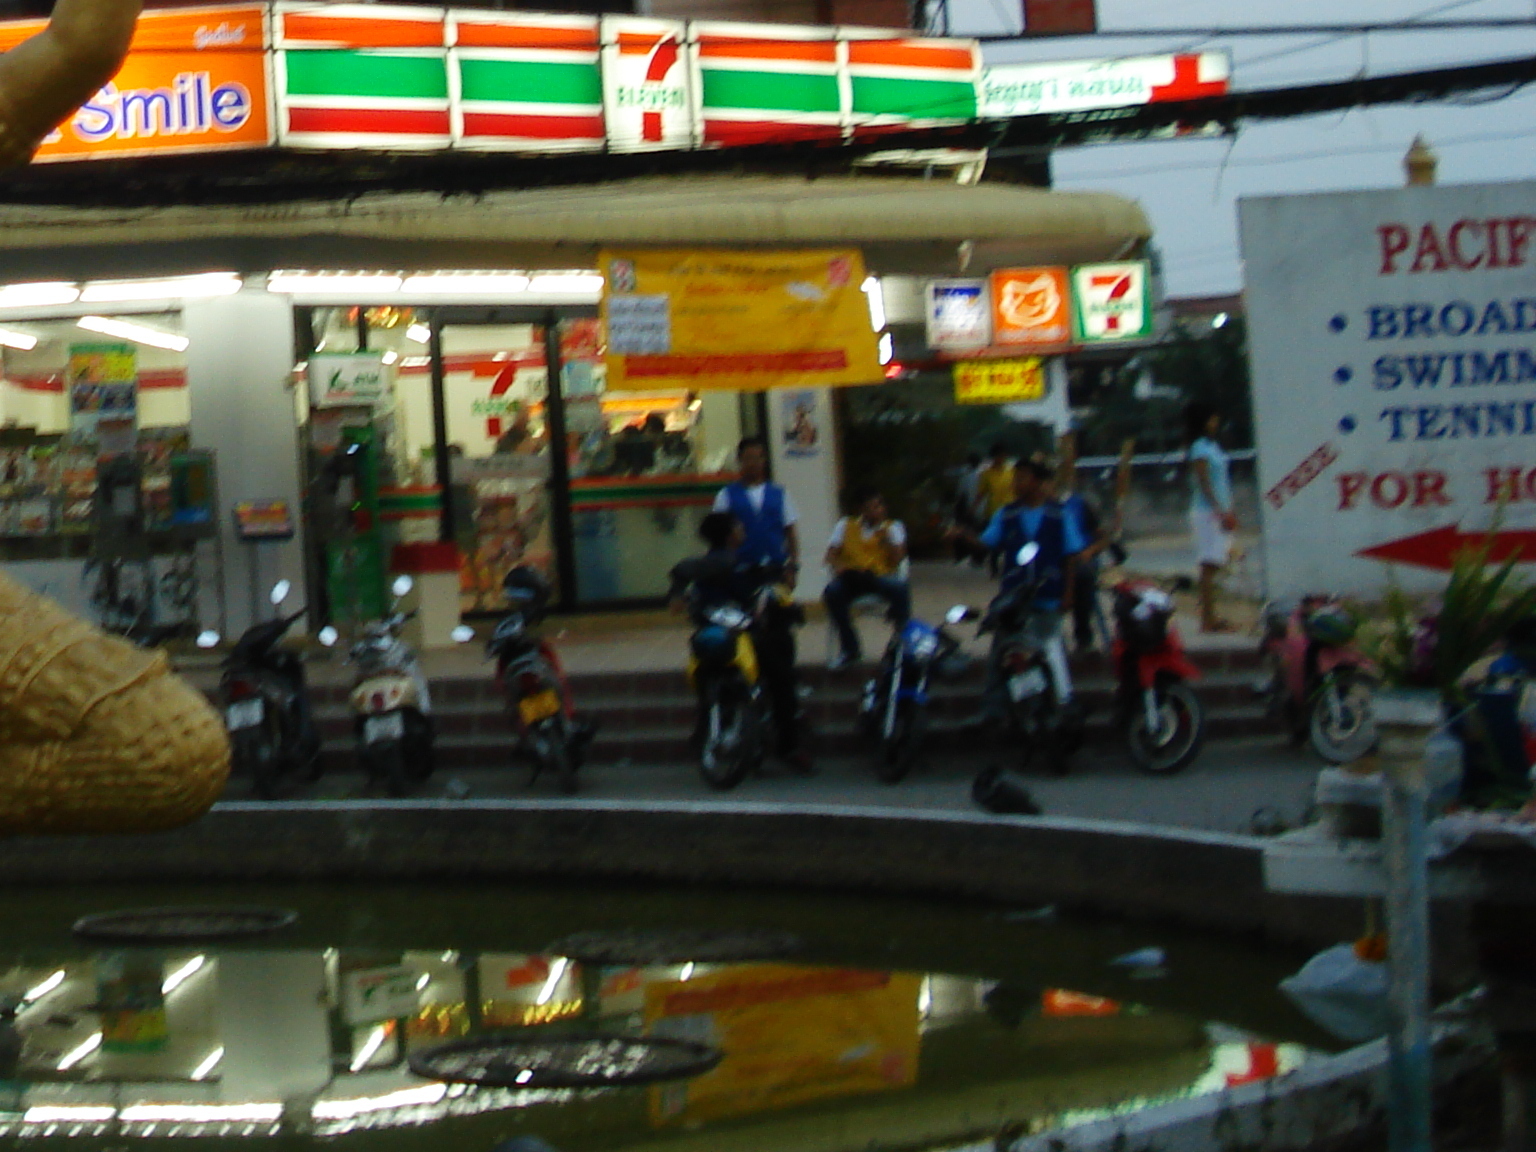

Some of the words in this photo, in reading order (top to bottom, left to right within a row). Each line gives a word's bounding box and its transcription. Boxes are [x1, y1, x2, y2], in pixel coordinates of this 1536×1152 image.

[73, 72, 251, 141] Smile
[1263, 440, 1343, 510] FREE
[1334, 467, 1453, 512] FOR
[1482, 463, 1536, 505] H
